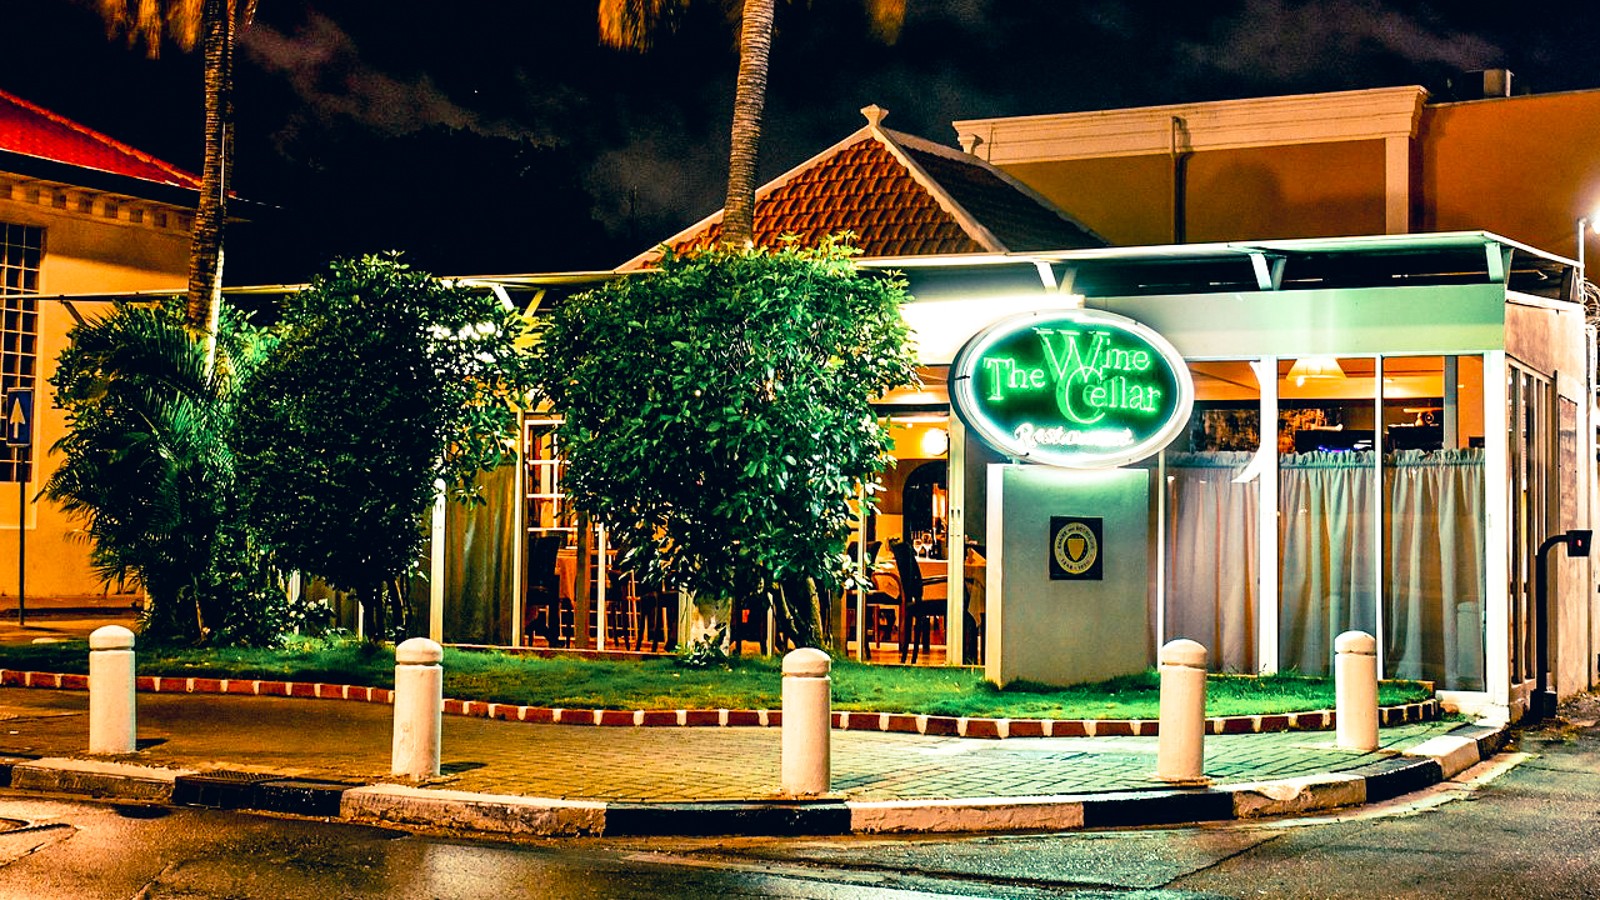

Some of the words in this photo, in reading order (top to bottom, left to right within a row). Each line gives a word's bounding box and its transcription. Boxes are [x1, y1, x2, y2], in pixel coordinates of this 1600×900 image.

[983, 357, 1046, 401] The
[1033, 326, 1151, 384] Wine
[1056, 365, 1161, 424] Cellar
[1014, 422, 1135, 449] Restat
